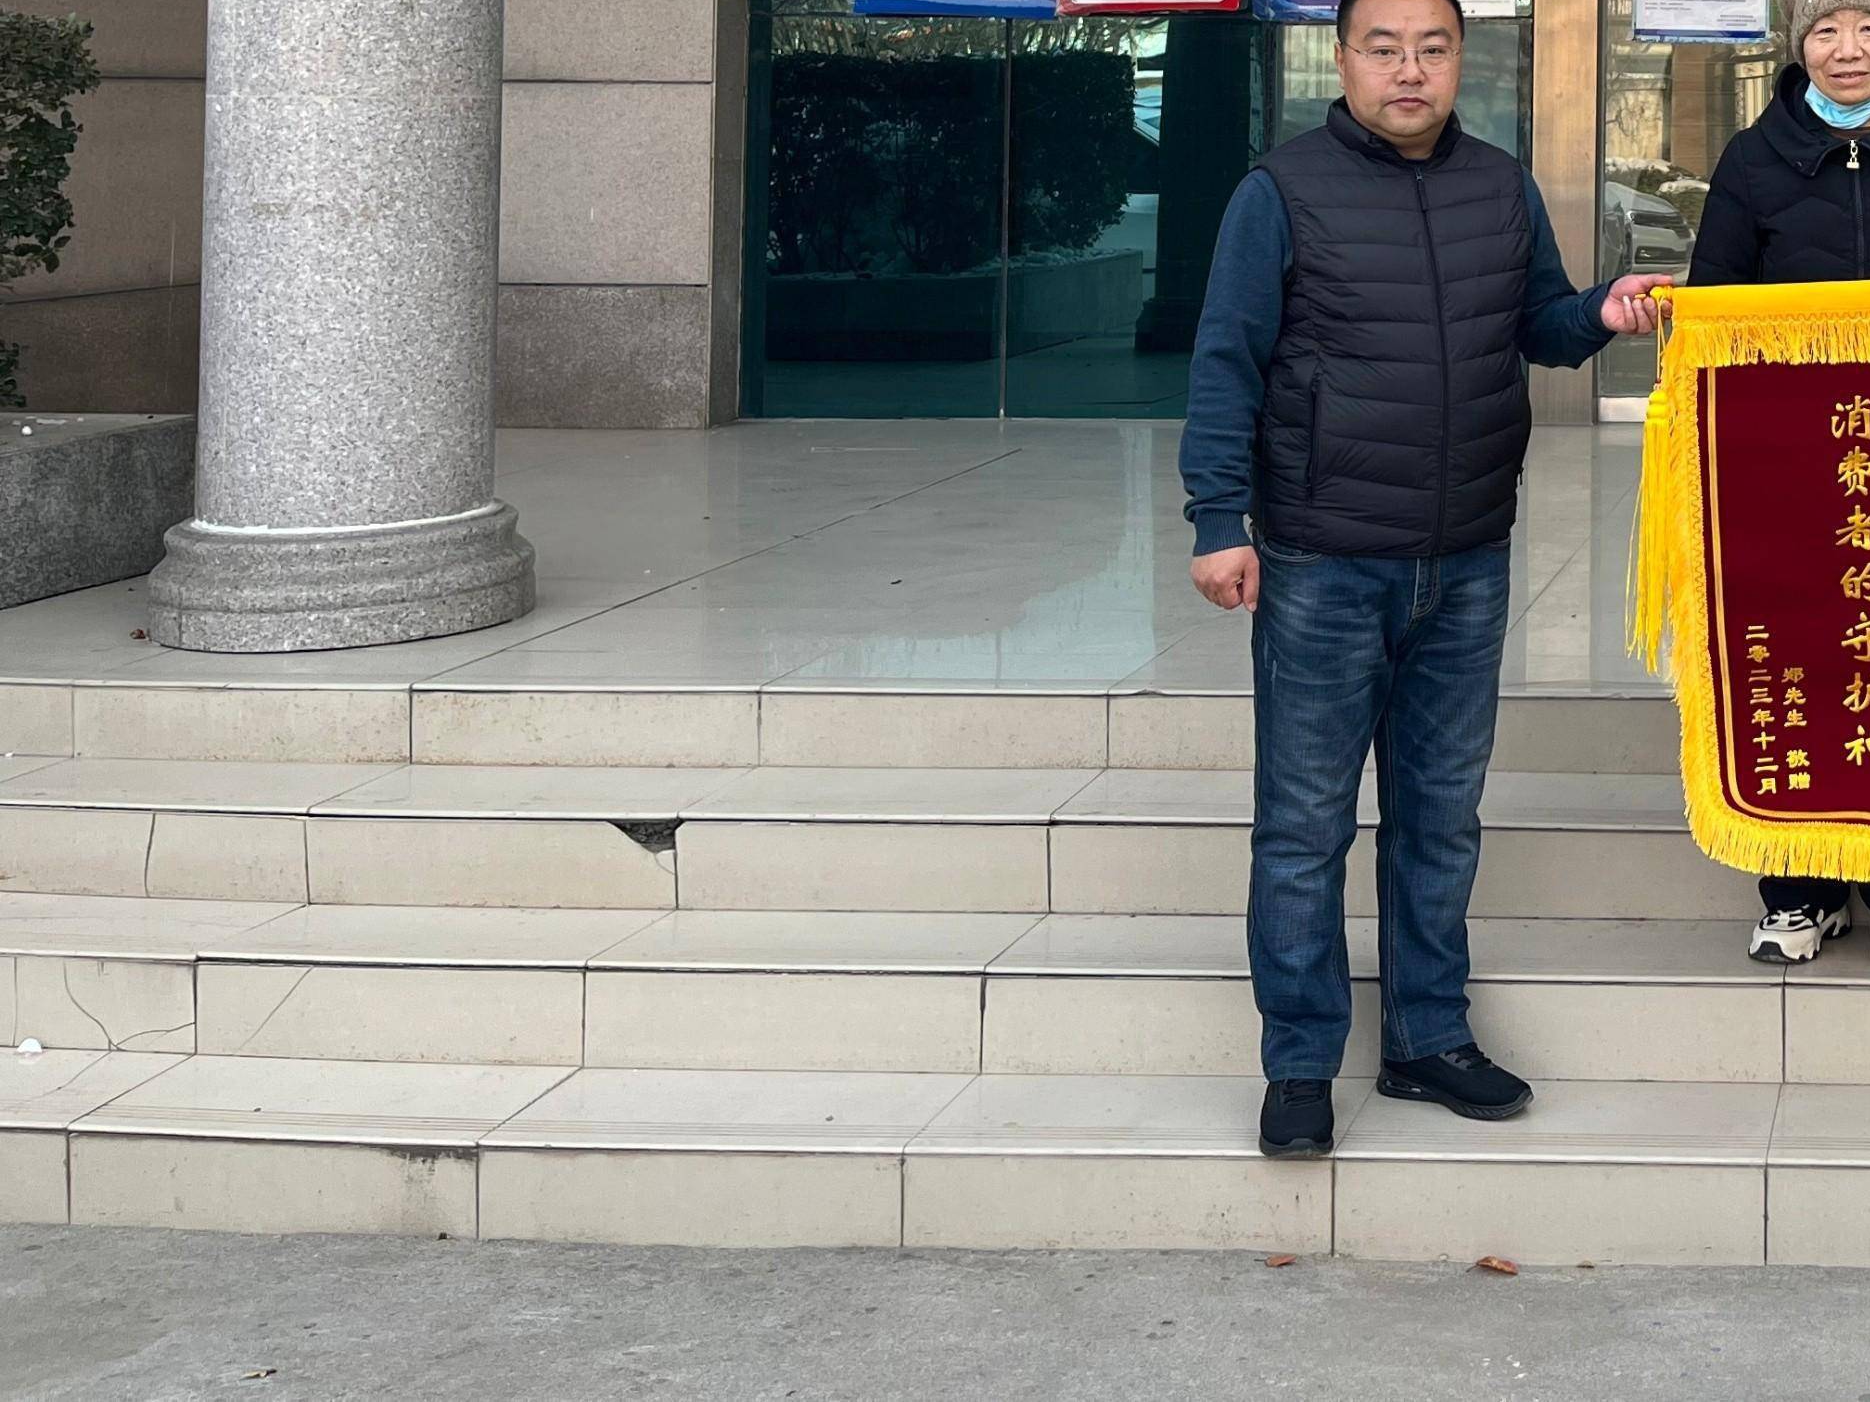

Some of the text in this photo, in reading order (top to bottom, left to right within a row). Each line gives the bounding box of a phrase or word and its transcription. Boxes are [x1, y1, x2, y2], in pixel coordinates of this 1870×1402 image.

[1745, 625, 1779, 795] 二零二三年十二月
